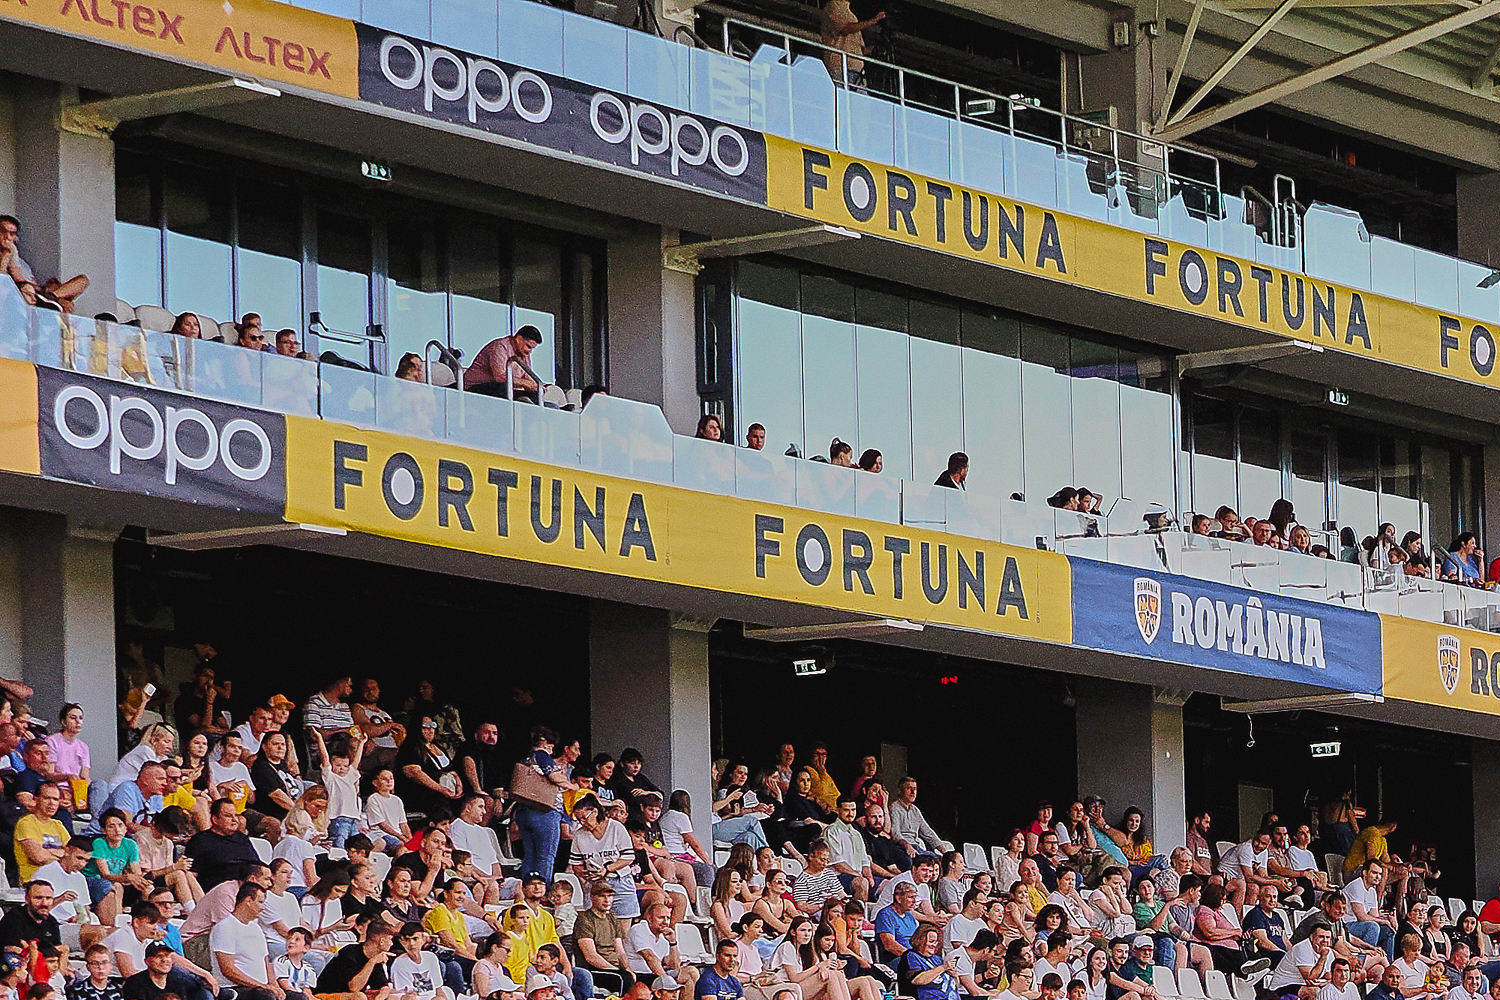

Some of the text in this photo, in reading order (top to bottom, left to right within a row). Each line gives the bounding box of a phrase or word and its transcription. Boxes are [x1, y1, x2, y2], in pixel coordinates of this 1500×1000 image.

[380, 35, 748, 177] oppo oppo
[802, 148, 1066, 274] FORTUNA
[1145, 238, 1372, 350] FORTUNA
[55, 385, 271, 485] oppo
[334, 440, 1029, 620] FORTUNA FORTUNA
[1172, 592, 1325, 668] ROMÂNIA
[599, 848, 618, 858] YORK
